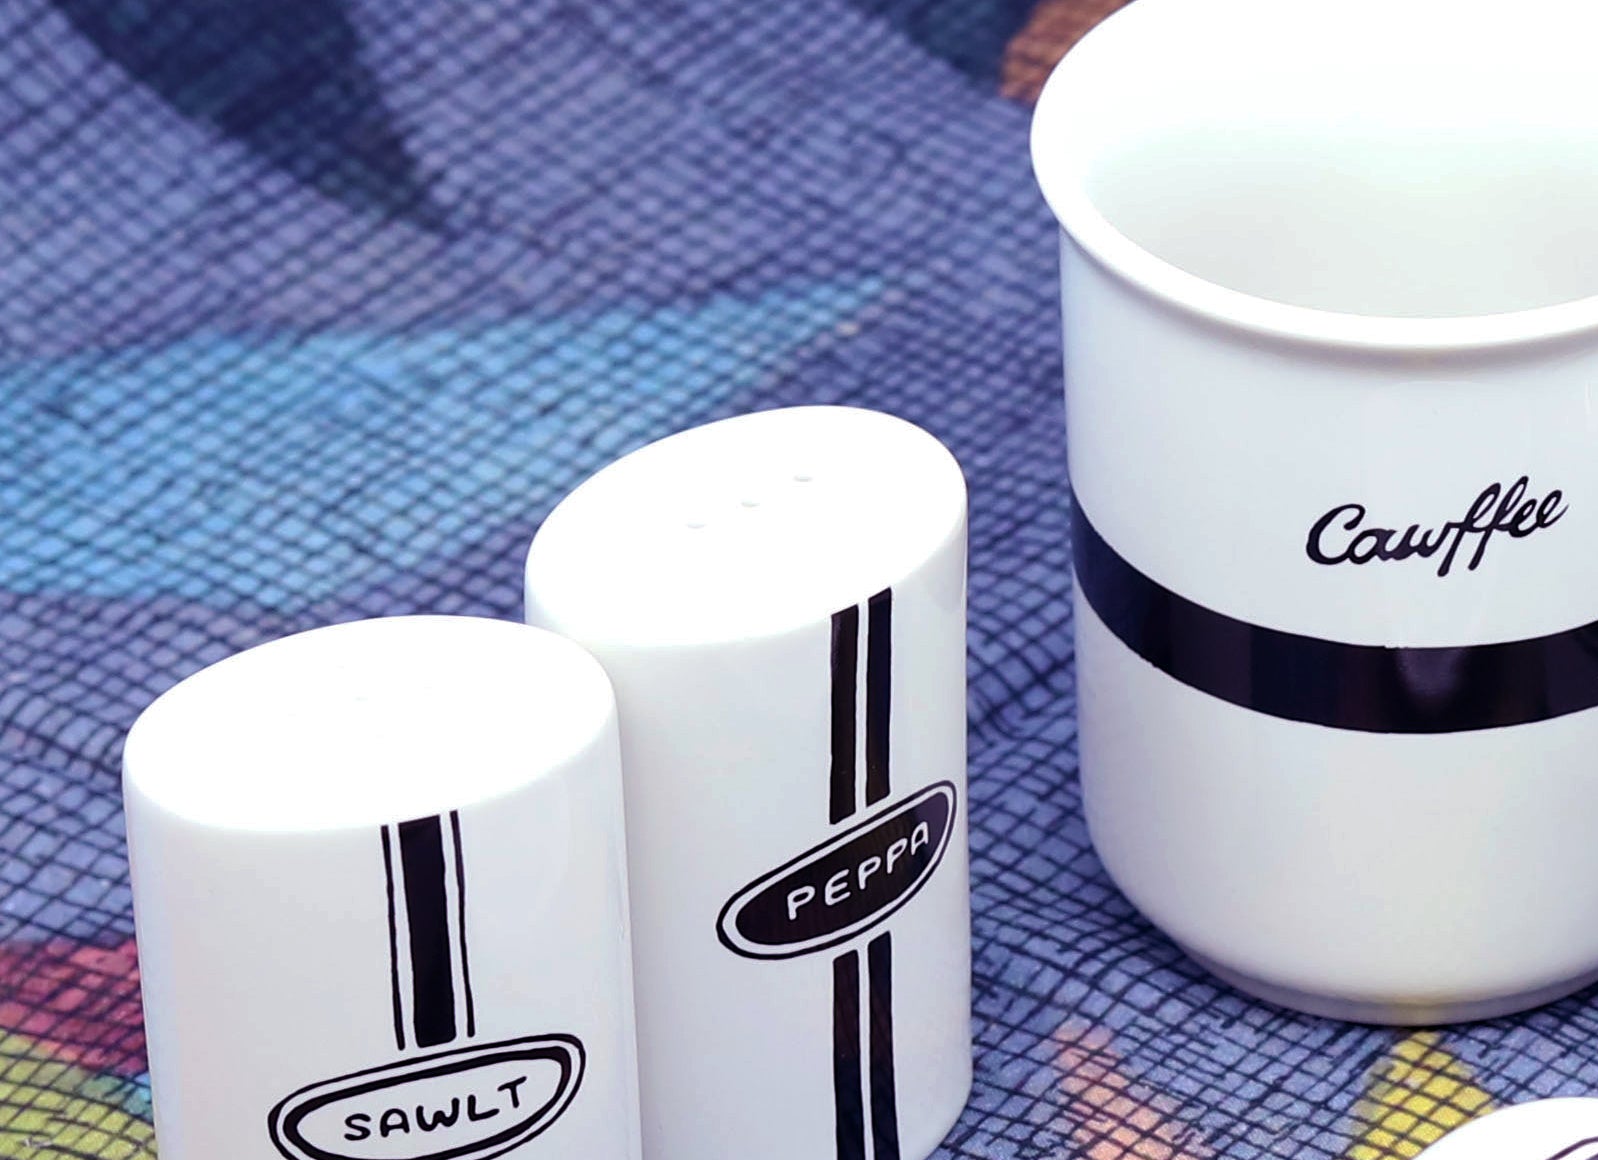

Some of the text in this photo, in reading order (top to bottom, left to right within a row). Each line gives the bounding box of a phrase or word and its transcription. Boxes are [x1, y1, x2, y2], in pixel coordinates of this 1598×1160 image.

[1304, 475, 1568, 578] Cawffee
[786, 822, 930, 921] PEPPA
[342, 1075, 528, 1143] SAWLT
